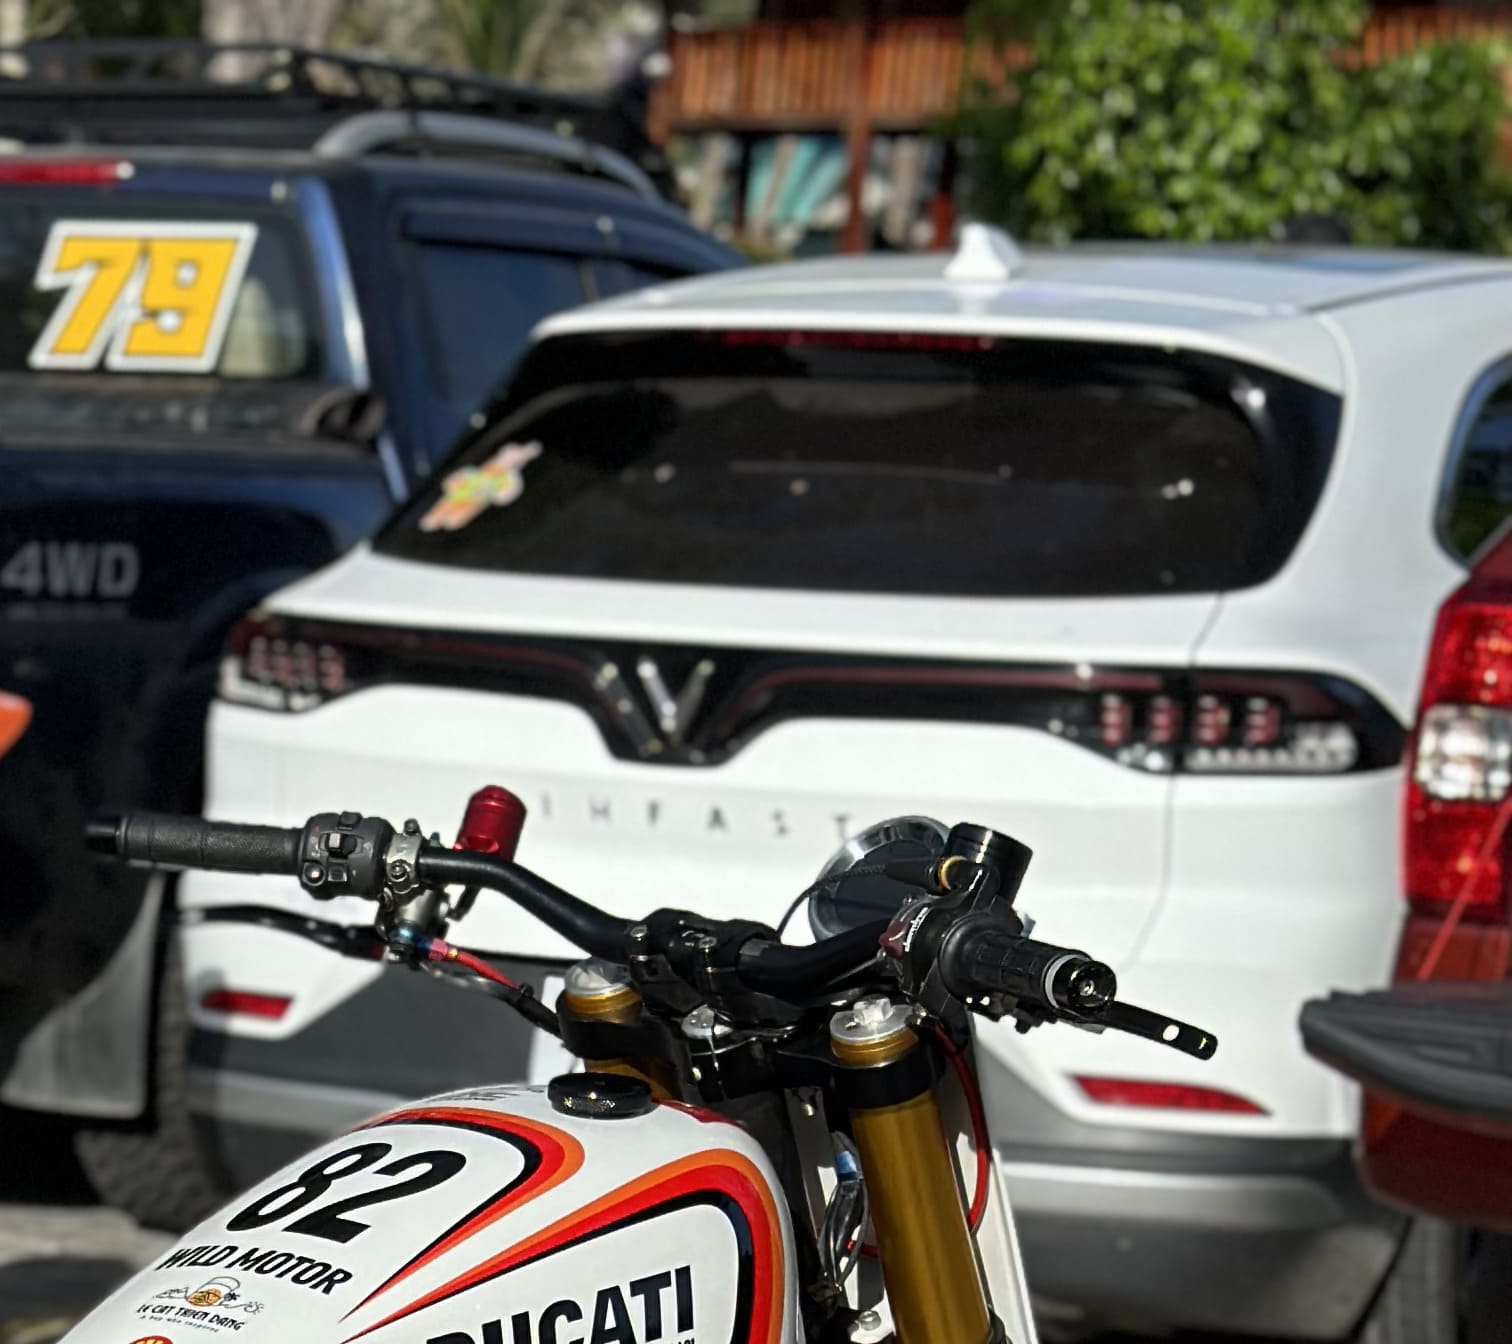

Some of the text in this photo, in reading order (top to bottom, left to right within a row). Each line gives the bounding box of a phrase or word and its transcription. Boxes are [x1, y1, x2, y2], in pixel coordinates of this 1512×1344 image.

[28, 220, 259, 373] 79
[540, 794, 852, 843] INFAST
[226, 1141, 467, 1244] 82
[155, 1244, 353, 1295] WILD MOTOR
